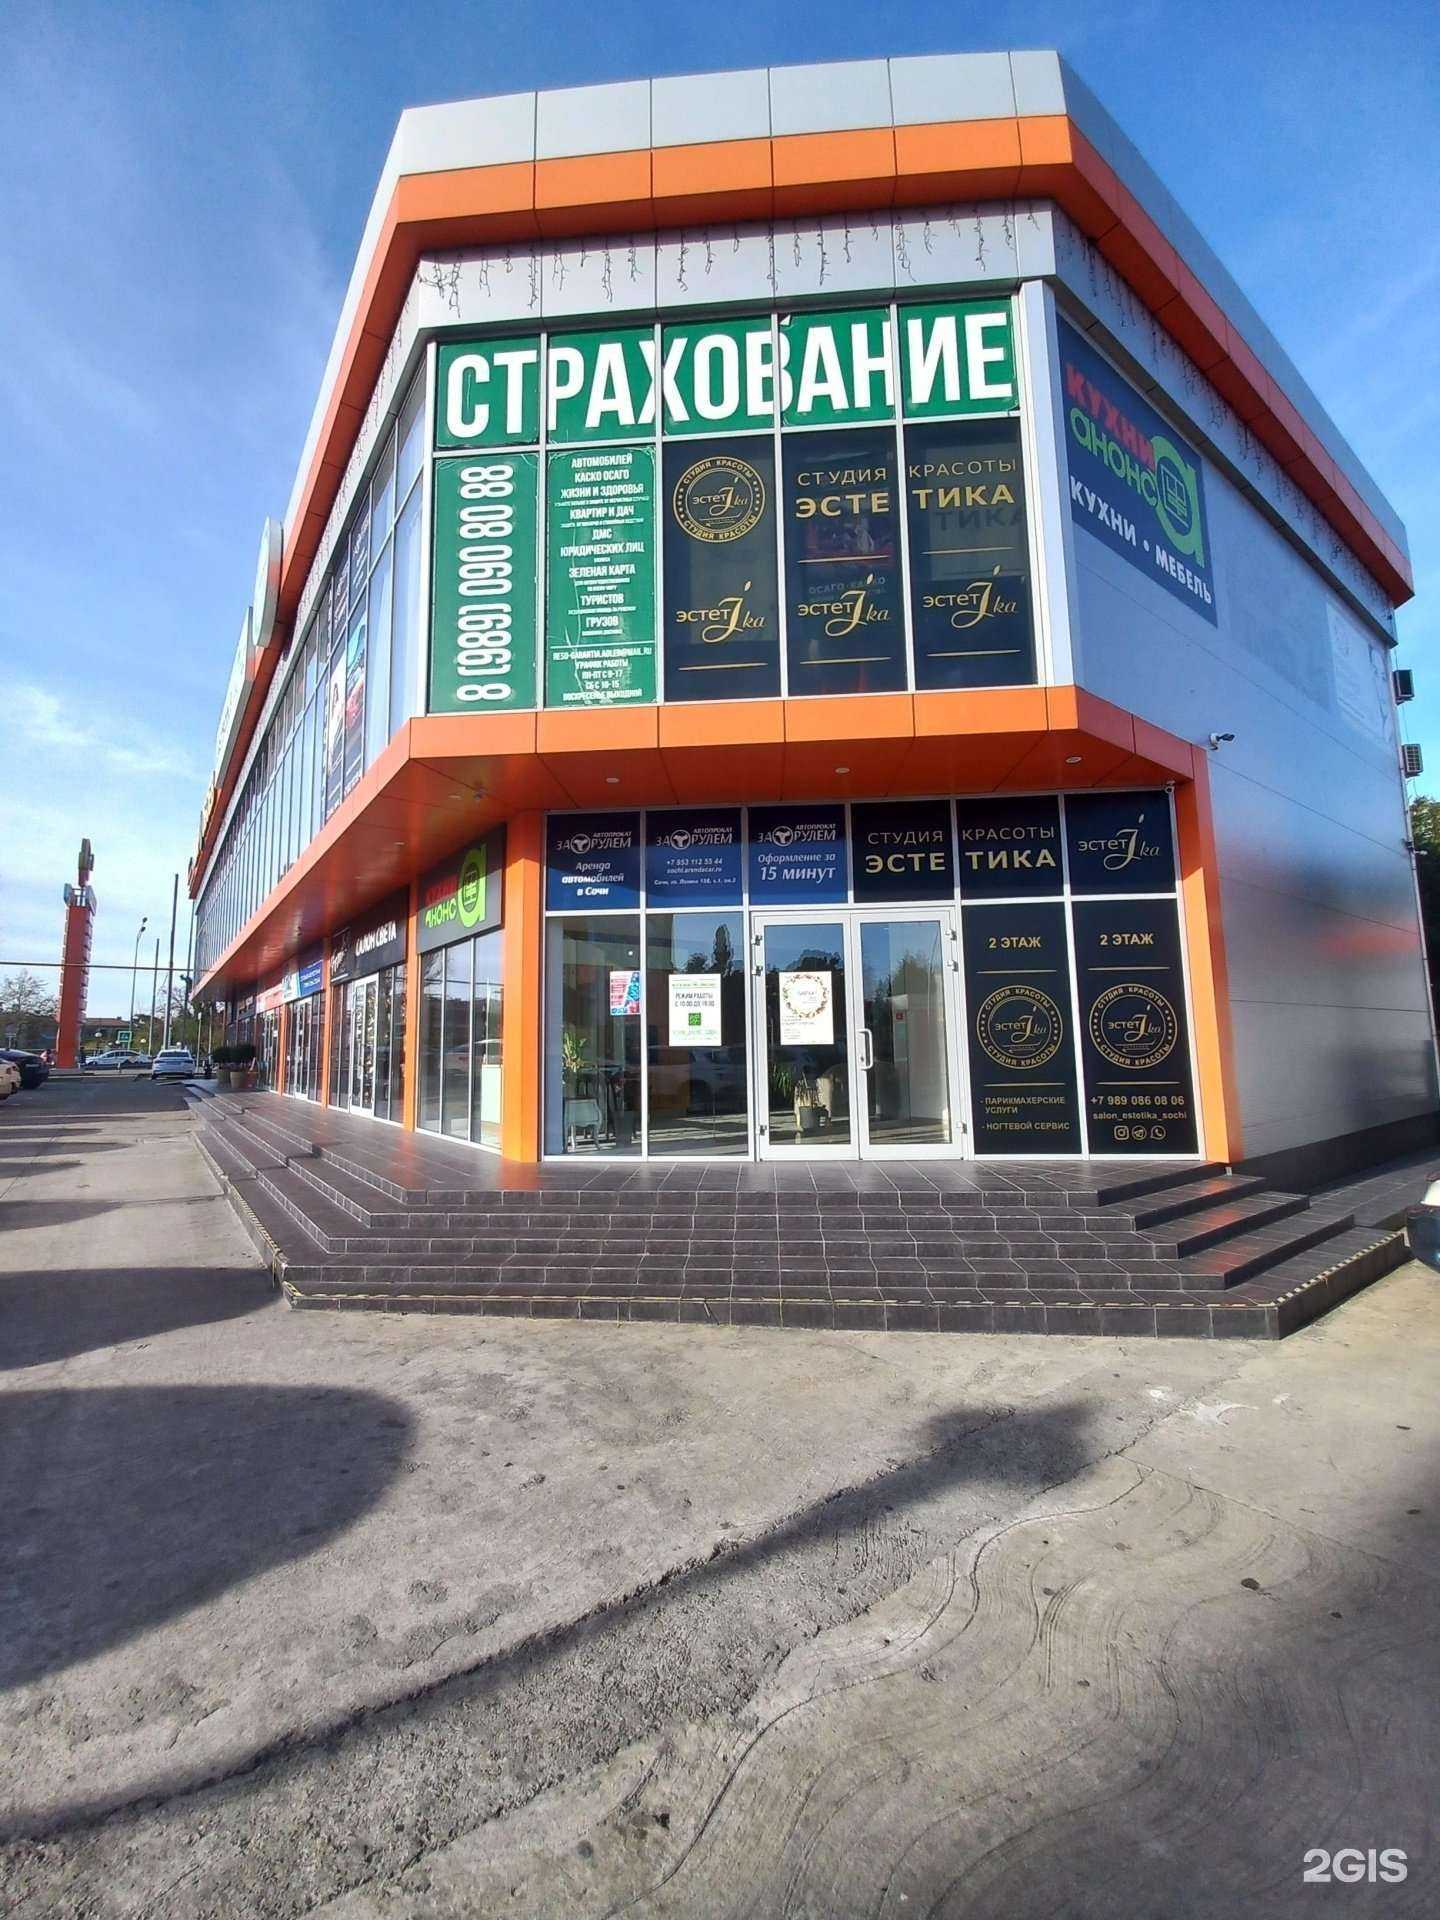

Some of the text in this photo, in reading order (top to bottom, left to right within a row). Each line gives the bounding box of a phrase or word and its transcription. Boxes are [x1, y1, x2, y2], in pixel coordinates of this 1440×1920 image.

[446, 313, 1013, 438] СТРАХОВАНИЕ
[1066, 362, 1156, 472] КУХНИ
[571, 453, 633, 468] АВТОМОБИЛЕЙ
[575, 469, 630, 483] КАСКО ОСАГО
[683, 459, 754, 484] СТУДИЯ КРАСОТЫ
[797, 459, 1016, 487] СТУДИЯ КРАСОТЫ
[561, 484, 644, 498] ЖИЗНИ И ЗДОРОВЬЯ
[795, 484, 1015, 518] ЭСТЕ ТИКА
[570, 506, 634, 519] КВАРТИР И ДАЧ
[592, 528, 612, 540] ДМС
[683, 515, 757, 539] СТУДИЯ КРАСОТЫ
[1070, 475, 1212, 604] КУХНИ МЕБЕЛЬ
[560, 542, 645, 557] ЮРИДИЧЕСКИХ ЛИЦ
[569, 564, 636, 578] ЗЕЛЕНАЯ КАРТА
[457, 464, 514, 702] 8 (989) 090 80 88
[580, 593, 624, 605] ТУРИСТОВ
[586, 616, 618, 627] ГРУЗОВ
[656, 833, 732, 846] ЗА РУЛЕМ
[758, 830, 836, 843] ЗА РУЛЕМ
[867, 826, 1055, 845] СТУДИЯ КРАСОТЫ
[556, 837, 632, 850] ЗА РУЛЕМ
[757, 852, 835, 864] Оформление за
[865, 849, 1057, 873] ЭСТЕ ТИКА
[576, 862, 611, 872] Аренда
[561, 872, 624, 884] автомобилей
[760, 866, 836, 884] 15 минут
[577, 887, 609, 896] в Сочи
[989, 936, 1041, 948] 2 ЭТАЖ
[1100, 933, 1153, 945] 2 ЭТАЖ
[985, 988, 1051, 1010] СТУДИЯ КРАСОТЫ
[1097, 987, 1165, 1008] СТУДИЯ КРАСОТЫ
[988, 1043, 1056, 1066] СТУДИЯ КРАСОТЫ
[1100, 1044, 1170, 1065] СТУДИЯ КРАСОТЫ
[985, 1096, 1065, 1104] ПАРИКМАХЕРСКИЕ
[1091, 1095, 1185, 1105] +7 989 086 08 06
[985, 1106, 1018, 1114] УСЛУГИ
[986, 1121, 1070, 1130] НОГТЕВОЙ СЕРВИС
